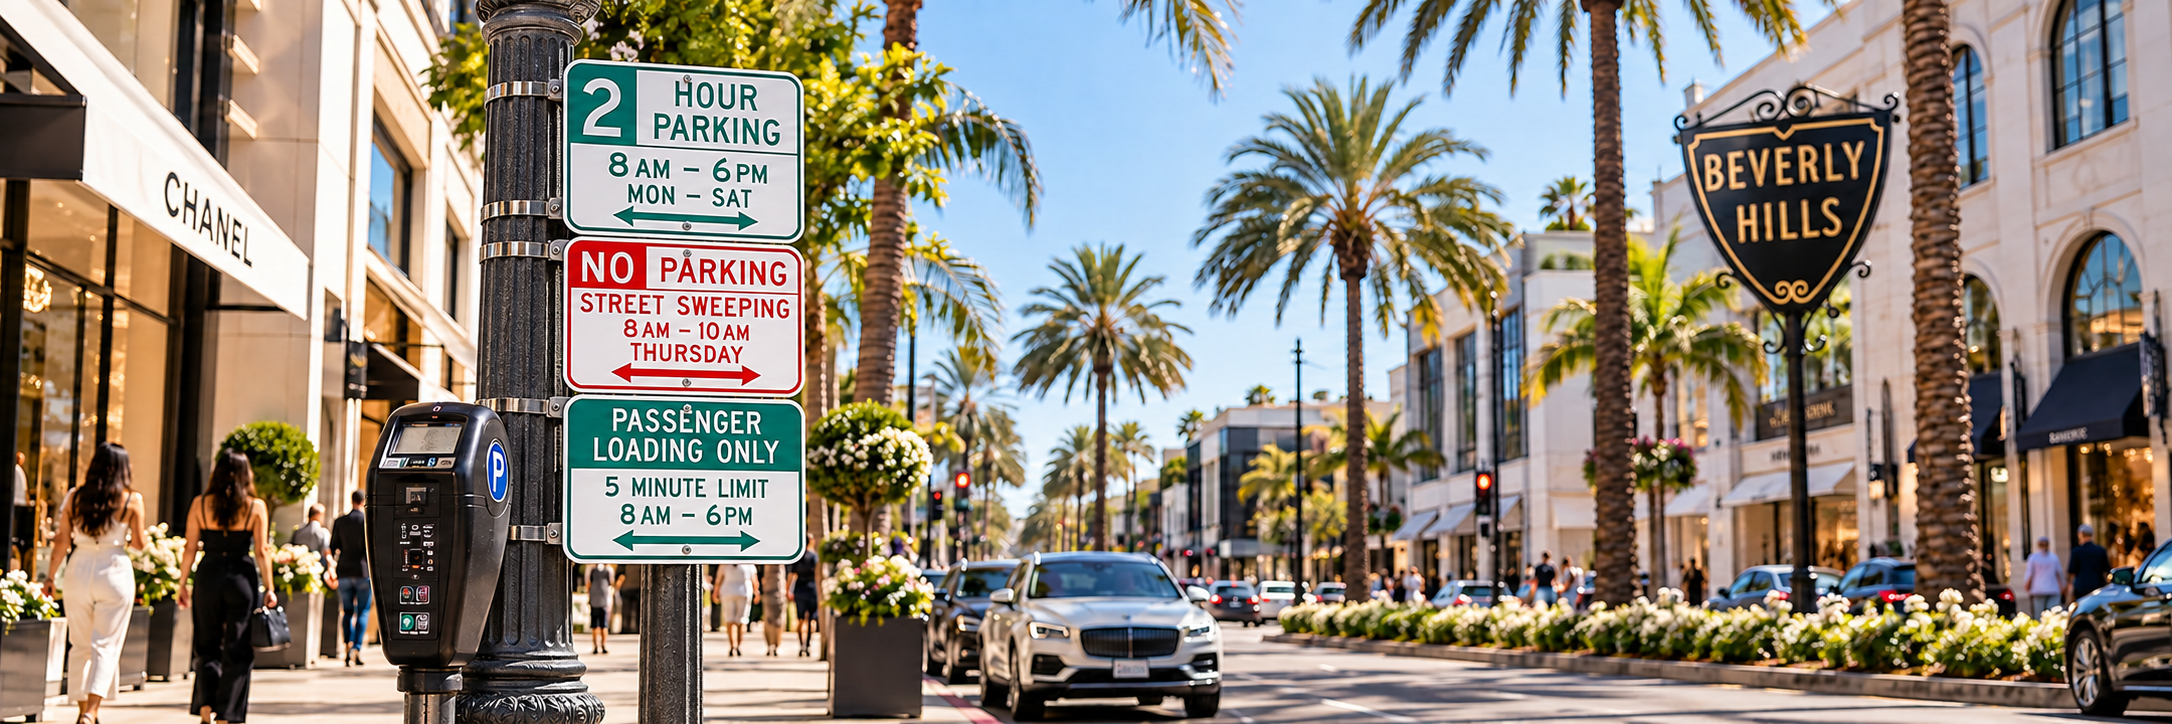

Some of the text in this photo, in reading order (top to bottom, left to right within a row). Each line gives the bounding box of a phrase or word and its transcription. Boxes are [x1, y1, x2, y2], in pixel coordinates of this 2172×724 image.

[581, 76, 623, 139] 2
[674, 79, 758, 111] HOUR
[653, 112, 781, 146] PARKING
[1704, 140, 1865, 192] BEVERLY
[627, 183, 676, 206] MON
[711, 187, 753, 209] SAT
[164, 171, 252, 268] CHANEL
[1735, 196, 1843, 244] HILLS
[580, 250, 788, 288] NO PARKING
[579, 291, 791, 320] STREET SWEEPING
[630, 342, 744, 365] THURSDAY
[611, 407, 763, 435] PASSENGER
[592, 436, 781, 465] LOADING ONLY
[492, 450, 505, 493] P
[603, 475, 770, 500] 5 MINUTE LIMIT
